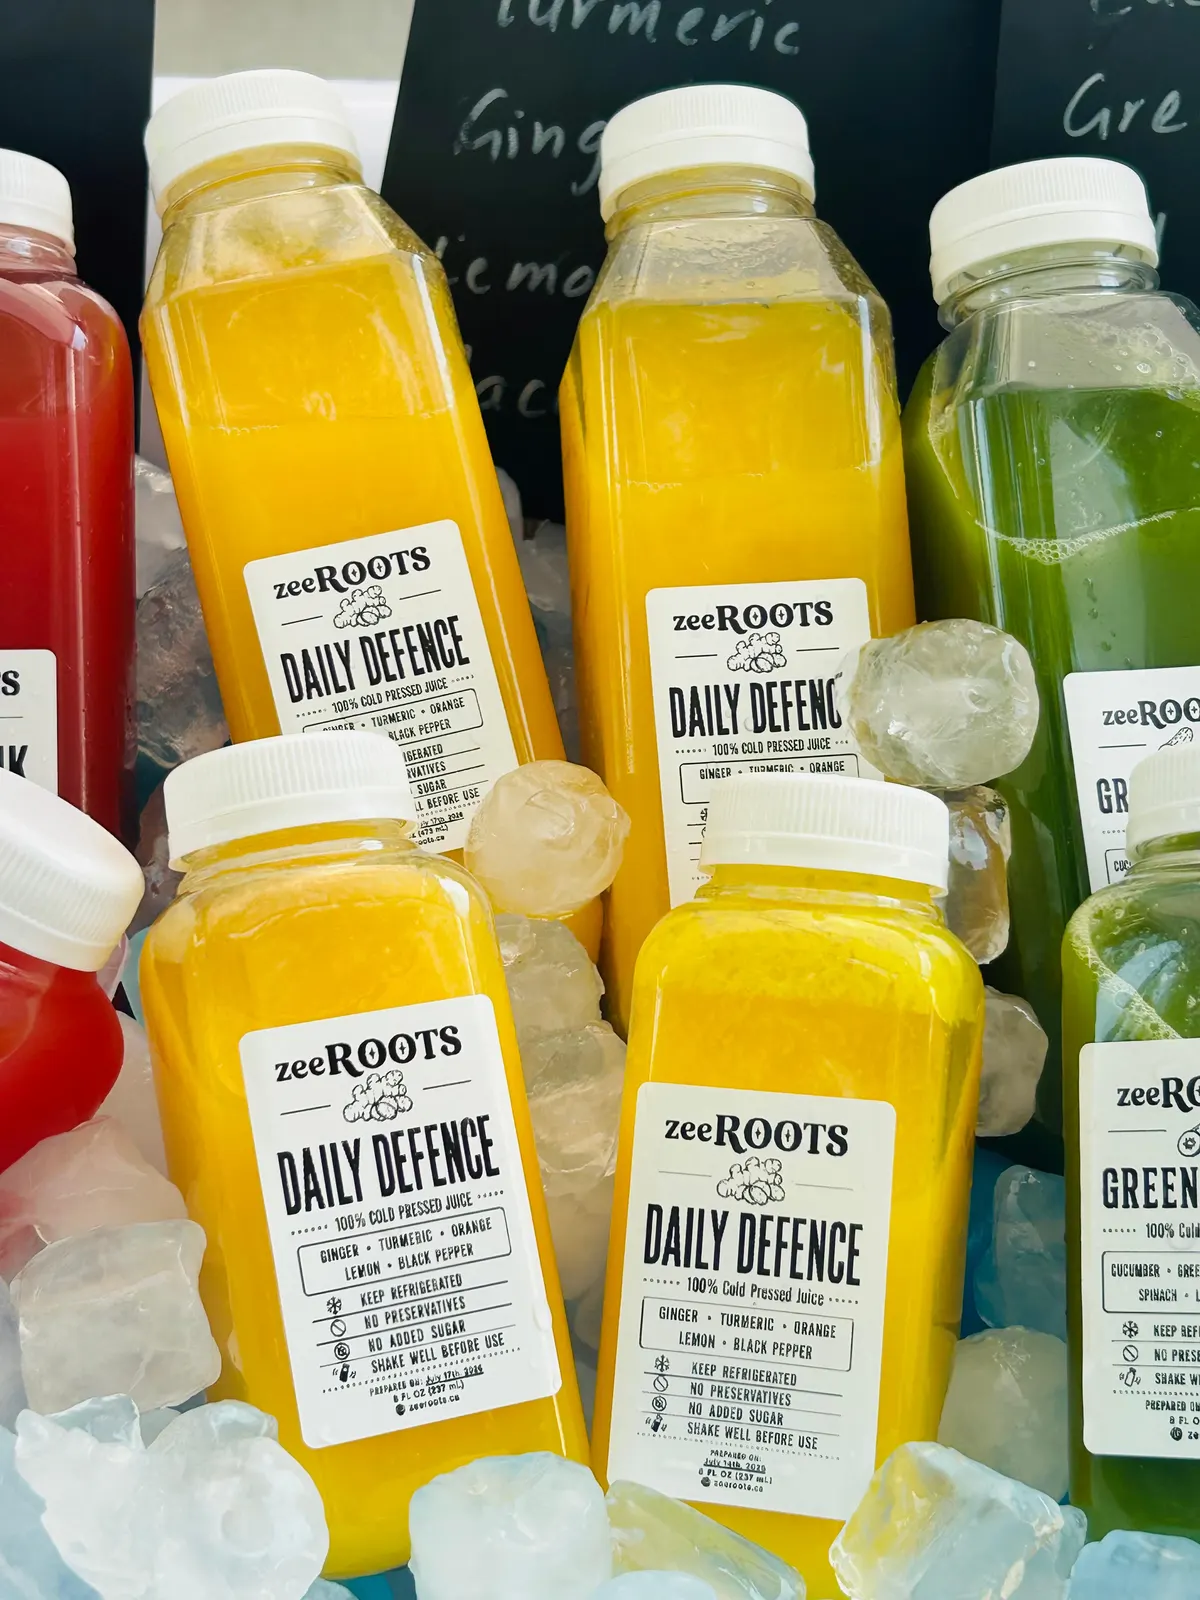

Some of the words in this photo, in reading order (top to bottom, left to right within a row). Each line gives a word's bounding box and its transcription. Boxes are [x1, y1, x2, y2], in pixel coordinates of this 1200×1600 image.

[273, 545, 432, 599] zeeROOTS
[672, 600, 834, 635] zeeROOTS
[280, 639, 355, 703] DAILY
[358, 615, 470, 686] DEFENCE
[332, 698, 359, 714] 100%
[361, 692, 383, 708] COLD
[385, 684, 423, 702] PRESSED
[425, 677, 449, 693] JUICE
[669, 683, 740, 738] DAILY
[749, 671, 843, 734] DEFENC
[371, 709, 416, 727] TURMERIC
[430, 697, 465, 715] ORANGE
[420, 718, 452, 735] PEPPER
[712, 743, 738, 756] 100%
[741, 742, 764, 755] COLD
[767, 739, 805, 752] PRESSED
[807, 737, 831, 751] JUICE
[700, 767, 732, 779] GINGER
[809, 760, 845, 774] ORANGE
[417, 779, 447, 794] SUGAR
[426, 792, 460, 809] BEFORE
[462, 787, 480, 800] USE
[274, 1024, 463, 1082] zeeROOTS
[664, 1113, 849, 1157] zeeROOTS
[277, 1137, 363, 1216] DAILY
[371, 1114, 501, 1199] DEFENCE
[1102, 1166, 1199, 1209] GREEN
[335, 1212, 366, 1232] 100%
[369, 1206, 395, 1225] COLD
[398, 1198, 443, 1220] PRESSED
[445, 1191, 473, 1210] JUICE
[320, 1244, 359, 1263] GINGER
[378, 1229, 433, 1251] TURMERIC
[451, 1217, 492, 1237] ORANGE
[643, 1203, 729, 1272] DAILY
[737, 1212, 863, 1287] DEFENCE
[1145, 1222, 1175, 1239] 100%
[345, 1261, 381, 1281] LEMON
[398, 1251, 431, 1270] BLACK
[435, 1243, 474, 1262] PEPPER
[1111, 1263, 1160, 1278] CUCUMBER
[360, 1289, 385, 1307] KEEP
[390, 1273, 463, 1300] REFRIGERATED
[687, 1276, 718, 1295] 100%
[722, 1280, 746, 1298] Cold
[750, 1283, 792, 1303] Pressed
[796, 1287, 824, 1306] Juice
[1138, 1288, 1178, 1302] SPINACH
[364, 1314, 379, 1329] NO
[385, 1296, 466, 1324] PRESERVATIVES
[659, 1306, 698, 1323] GINGER
[720, 1312, 774, 1331] TURMERIC
[794, 1320, 837, 1339] ORANGE
[368, 1338, 383, 1352] NO
[390, 1328, 424, 1348] ADDED
[431, 1319, 466, 1339] SUGAR
[1153, 1324, 1178, 1337] KEEP
[371, 1354, 405, 1374] SHAKE
[409, 1346, 437, 1365] WELL
[441, 1338, 480, 1358] BEFORE
[485, 1332, 505, 1349] USE
[679, 1331, 715, 1349] LEMON
[733, 1337, 767, 1355] BLACK
[772, 1341, 813, 1360] PEPPER
[1154, 1348, 1168, 1361] NO
[691, 1361, 717, 1377] KEEP
[722, 1365, 797, 1386] REFRIGERATED
[1154, 1372, 1186, 1386] SHAKE
[413, 1388, 426, 1398] OZ
[428, 1384, 446, 1396] (237
[690, 1382, 704, 1396] NO
[710, 1384, 792, 1407] PRESERVATIVES
[1145, 1399, 1187, 1411] PREPARED
[688, 1401, 702, 1416] NO
[709, 1404, 743, 1421] ADDED
[749, 1409, 784, 1426] SUGAR
[1179, 1416, 1189, 1425] FL
[687, 1421, 720, 1437] SHAKE
[725, 1425, 751, 1441] WELL
[756, 1429, 794, 1447] BEFORE
[798, 1435, 818, 1450] USE
[720, 1470, 732, 1479] OZ
[735, 1472, 754, 1481] (237
